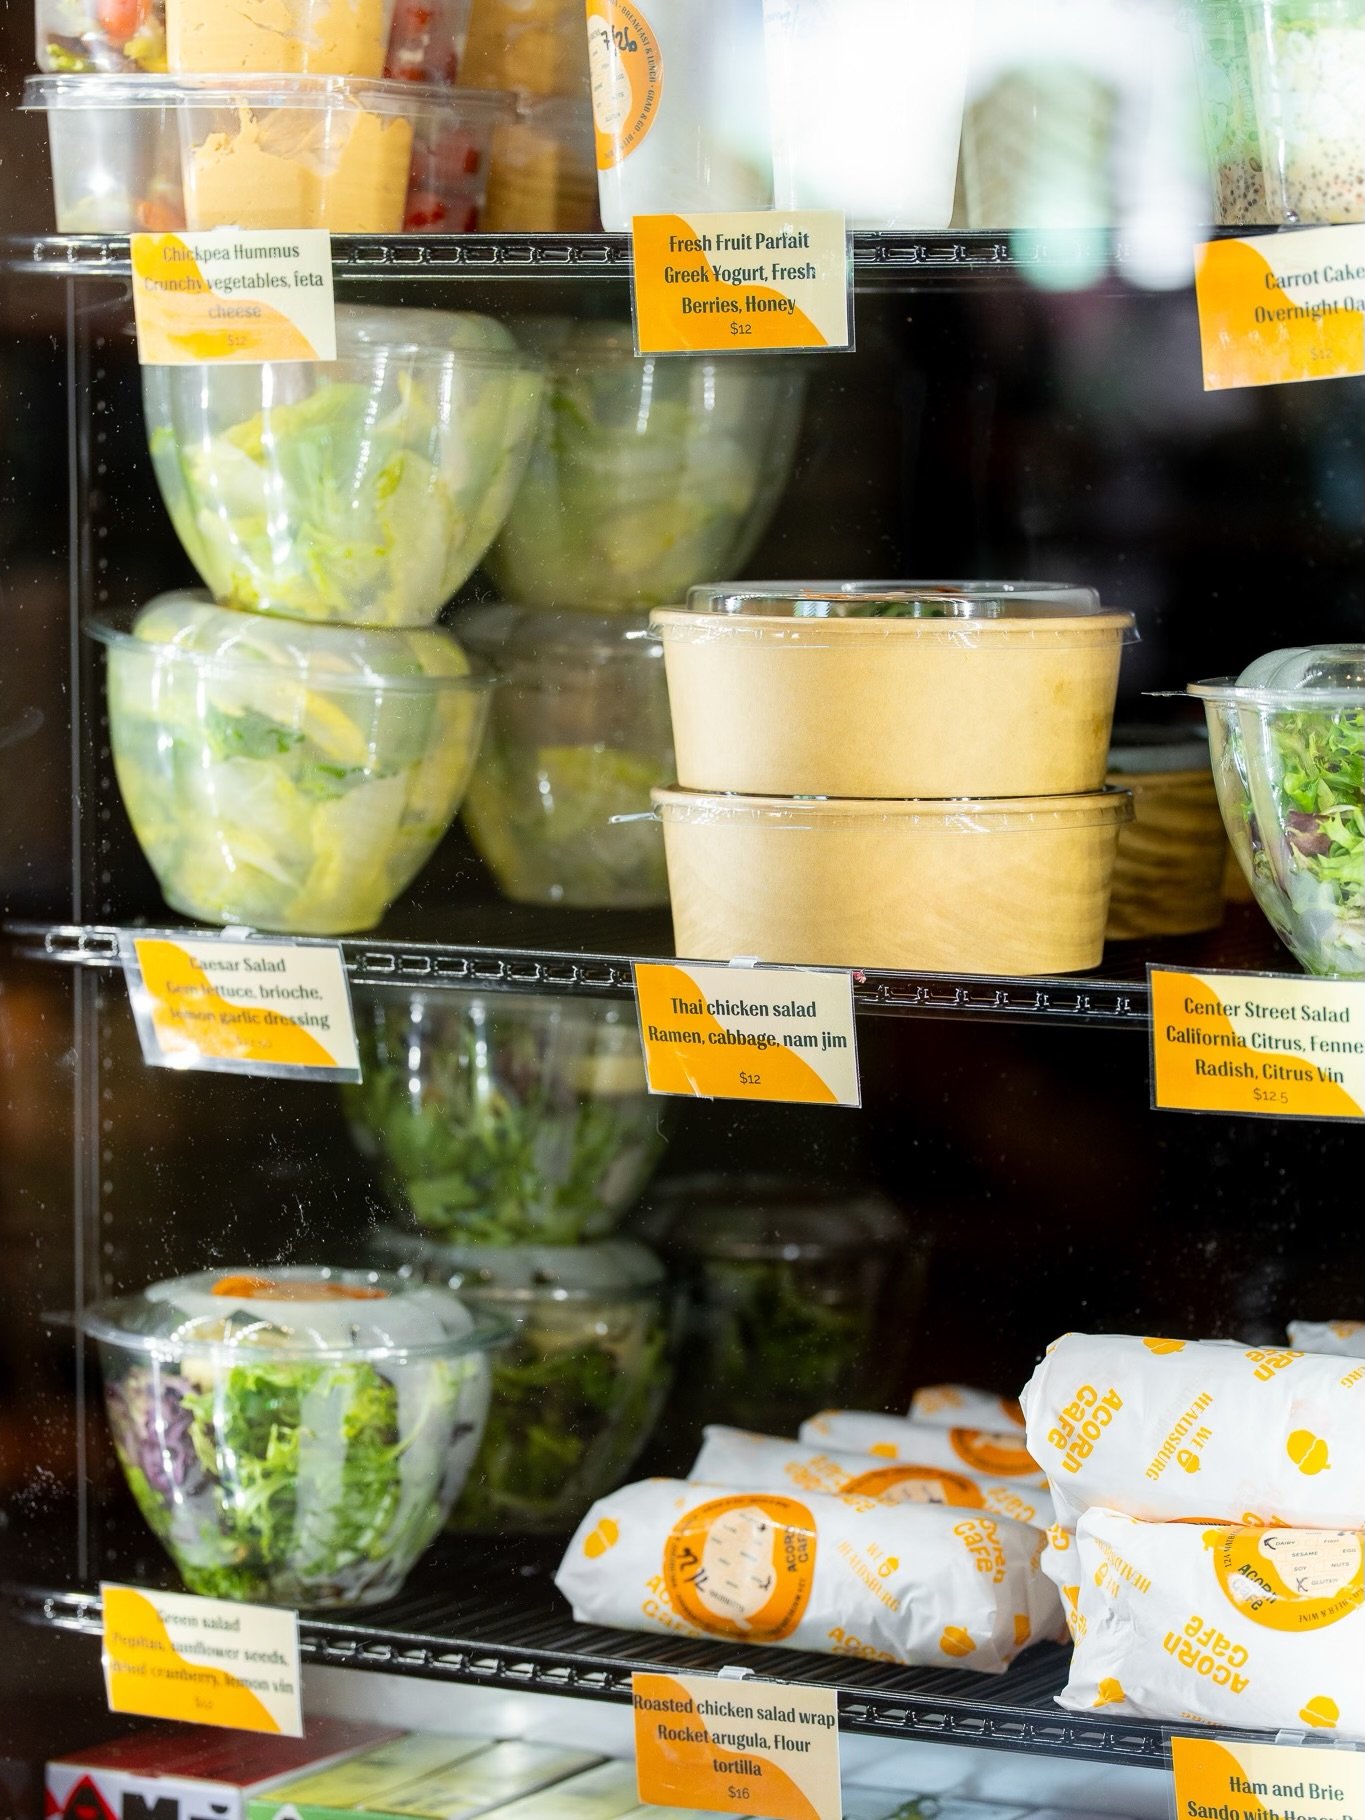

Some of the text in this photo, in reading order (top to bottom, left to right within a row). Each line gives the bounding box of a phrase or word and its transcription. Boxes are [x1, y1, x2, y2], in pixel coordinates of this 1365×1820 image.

[669, 231, 810, 253] Fresh Fruit Parfait
[163, 244, 300, 264] Chickpea Hummus
[144, 270, 323, 294] Crunchy vegetables, feta
[664, 262, 816, 286] Greek Yogurt, Fresh
[1264, 264, 1365, 290] Carrot Cake
[208, 304, 262, 319] cheese
[682, 295, 796, 315] Berries, Honey
[1254, 298, 1339, 324] Overnight
[730, 321, 752, 335] $12
[189, 956, 286, 973] Caesar Salad
[259, 984, 323, 1002] brioche,
[670, 998, 816, 1018] Thai chicken salad
[1184, 997, 1350, 1024] Center Street Salad
[220, 1011, 260, 1027] garlic
[264, 1012, 331, 1030] dressing
[648, 1025, 847, 1051] Ramen, cabbage, nam jim
[1166, 1025, 1247, 1048] California
[1251, 1032, 1307, 1053] Citrus,
[740, 1071, 761, 1085] $12
[1195, 1059, 1345, 1084] Radish, Citrus Vin
[1144, 1392, 1214, 1481] HEALDSBURG
[202, 1616, 241, 1632] salad
[634, 1694, 836, 1729] Roasted chicken salad wrap
[658, 1724, 811, 1752] Rocket arugula, Flour
[713, 1758, 762, 1776] tortilla
[728, 1785, 750, 1800] $16
[1229, 1777, 1344, 1801] Ham and Brie
[1187, 1800, 1240, 1820] Sando
